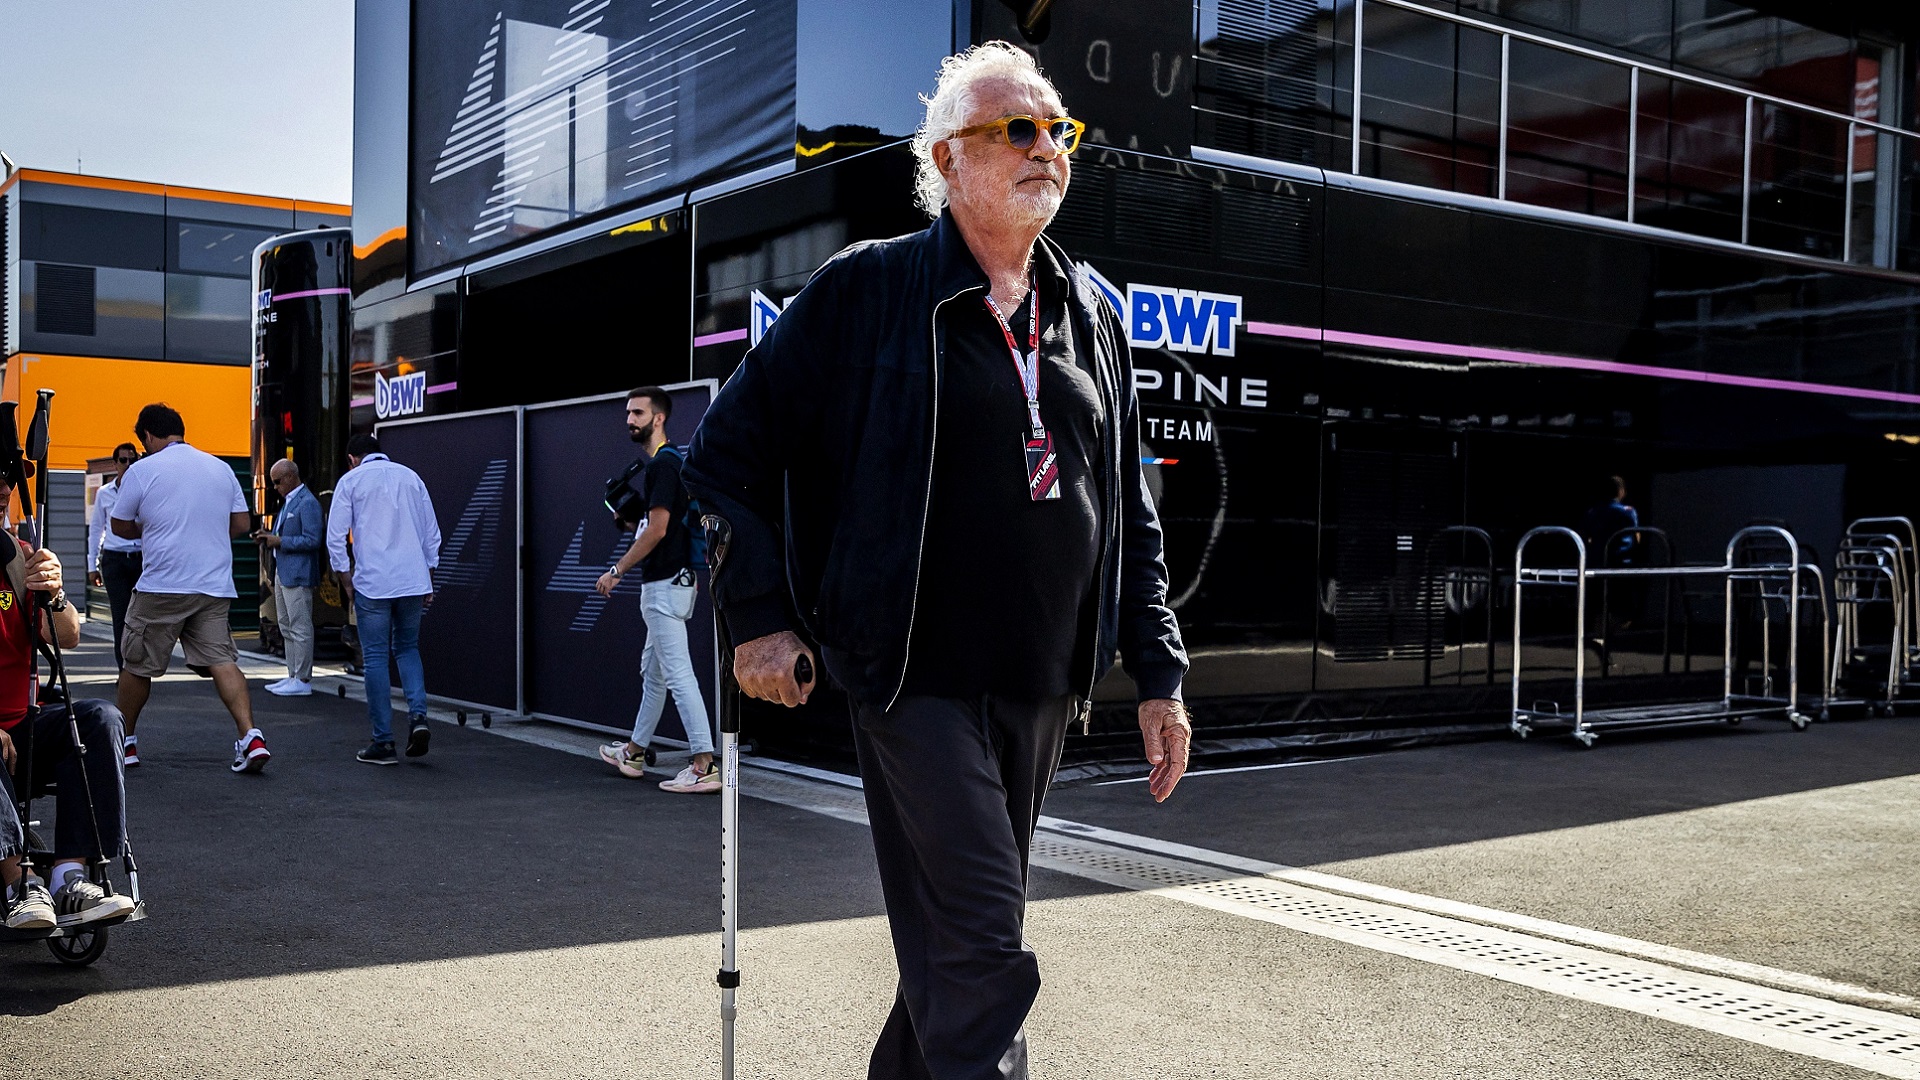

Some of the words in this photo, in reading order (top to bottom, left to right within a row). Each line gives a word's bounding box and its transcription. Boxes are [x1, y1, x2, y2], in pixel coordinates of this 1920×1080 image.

[1127, 283, 1242, 357] BWT
[388, 371, 425, 417] BWT
[1133, 368, 1267, 408] PINE
[1147, 418, 1212, 442] TEAM
[1031, 471, 1043, 489] PIT
[1039, 452, 1057, 475] LANE
